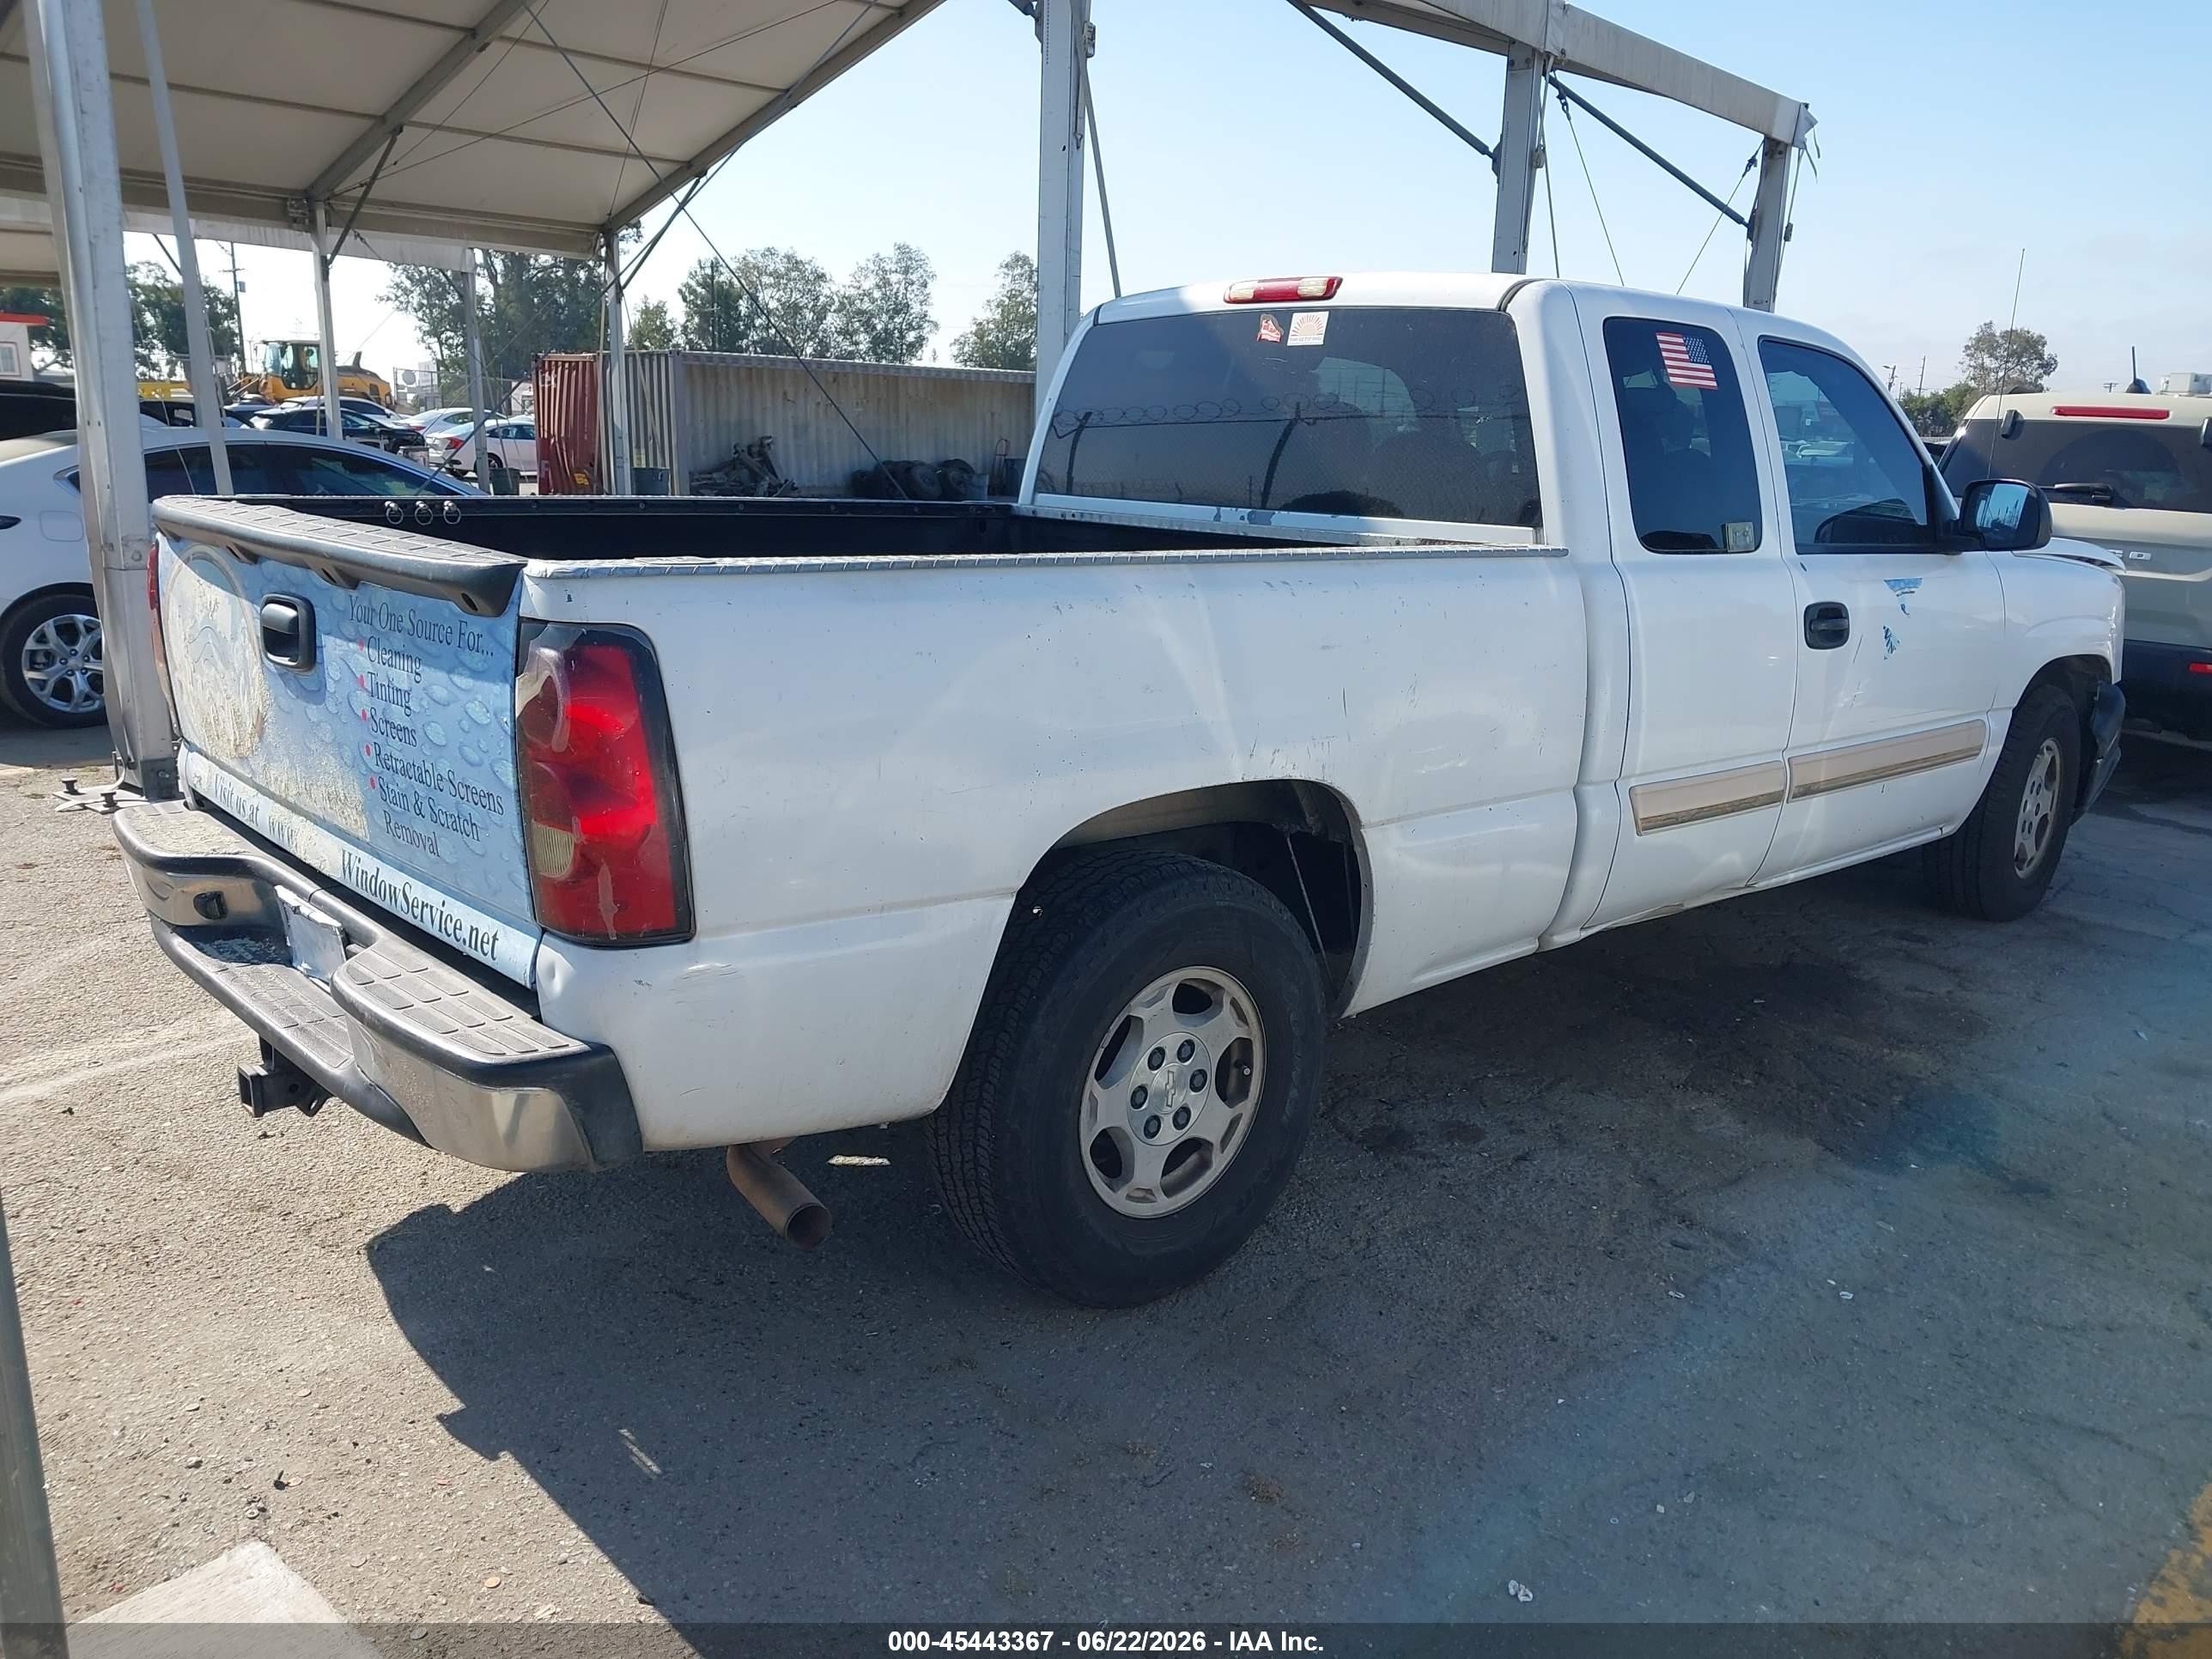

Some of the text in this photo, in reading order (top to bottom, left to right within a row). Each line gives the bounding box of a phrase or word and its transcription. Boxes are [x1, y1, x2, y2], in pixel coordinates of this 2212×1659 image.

[349, 594, 494, 657] Your One Source For...
[367, 635, 422, 684] Cleaning
[367, 672, 412, 718] Tinting
[369, 707, 417, 748] Screens
[374, 741, 505, 816] Retractable Screens
[378, 775, 481, 842] Stain & Scratch
[383, 809, 441, 858] Removal
[215, 773, 234, 811] Visit
[235, 796, 247, 818] us
[248, 800, 260, 827] at
[342, 848, 500, 961] WindowService.net
